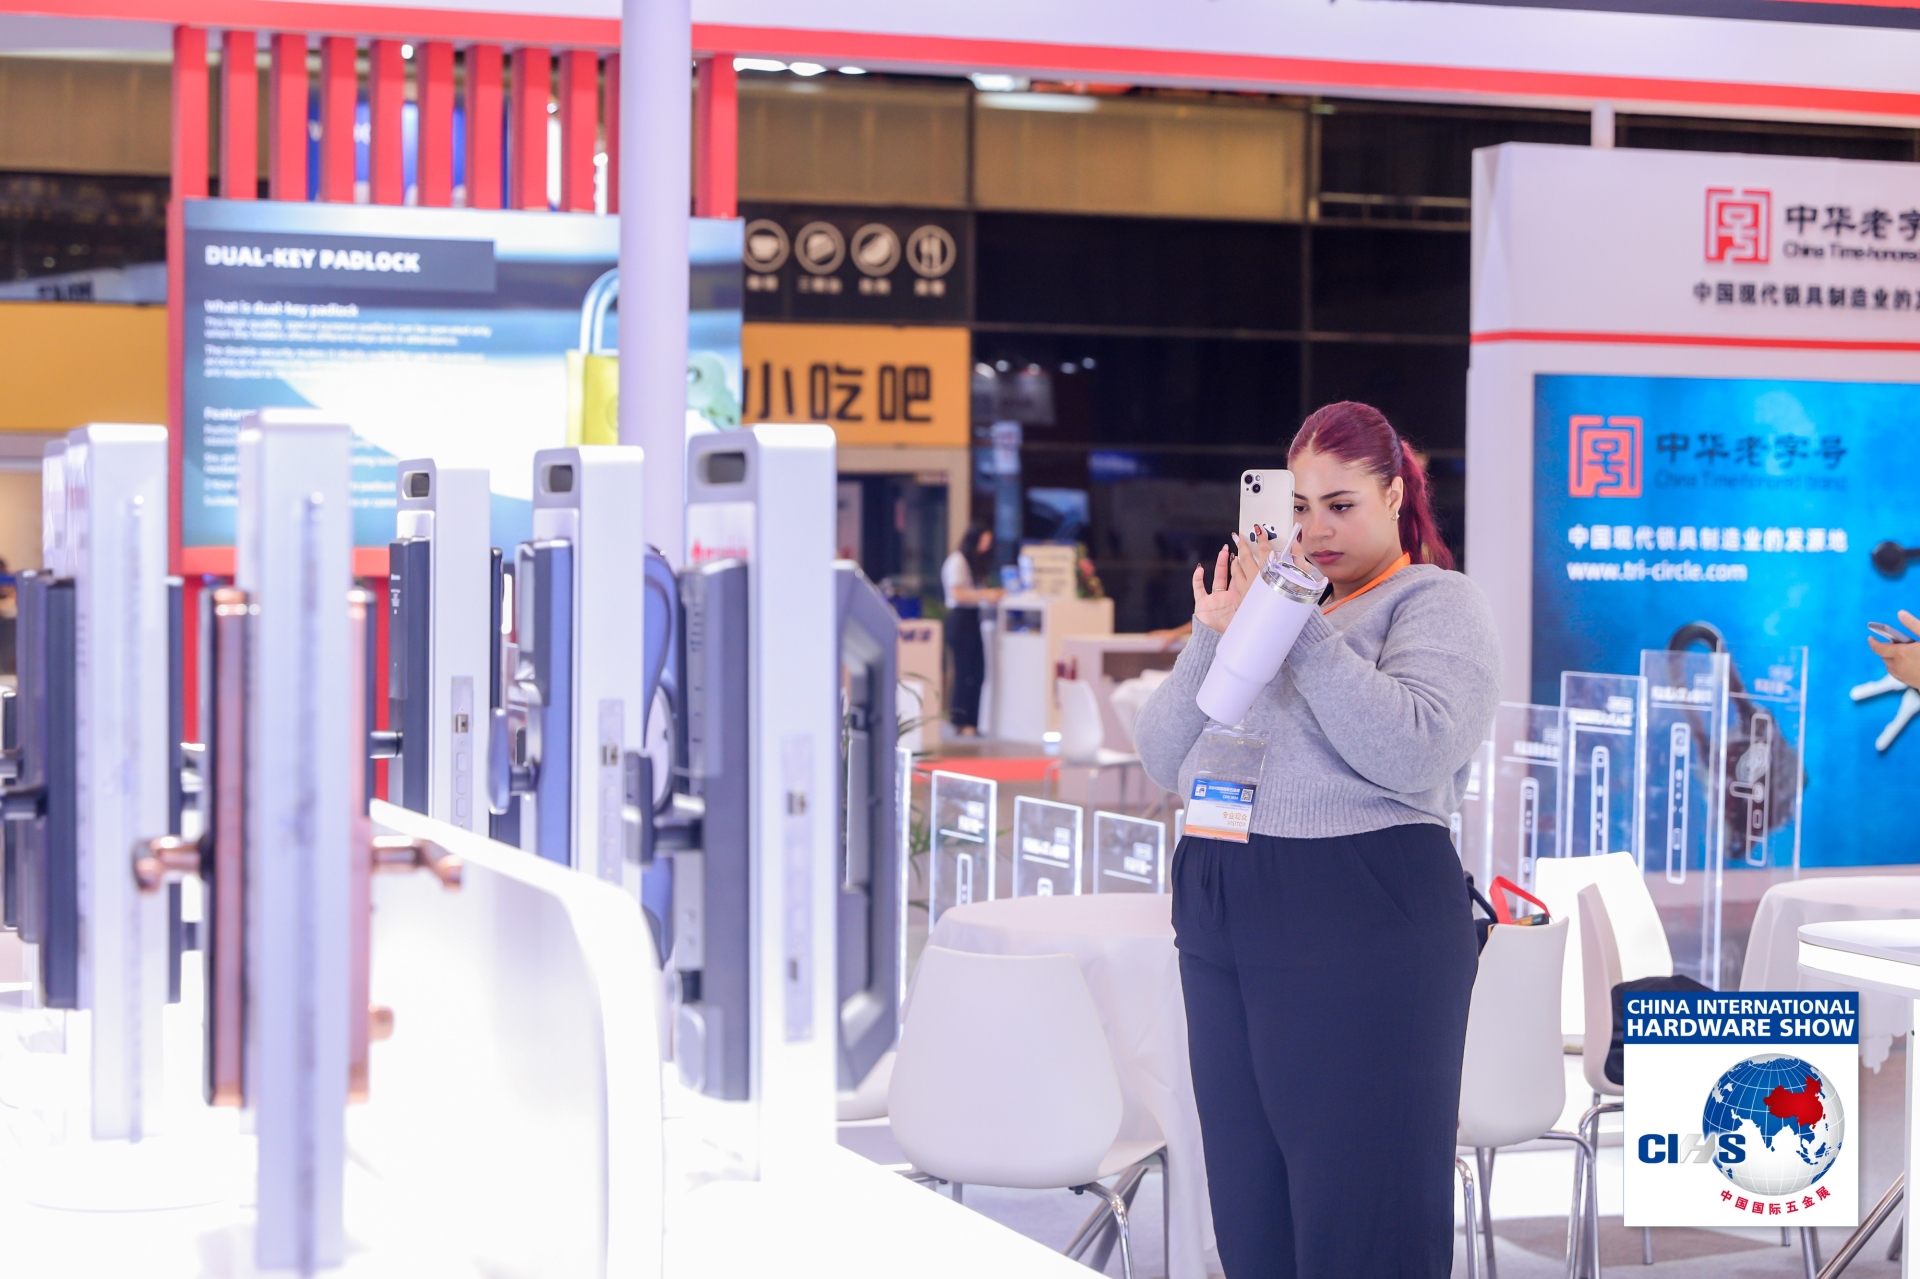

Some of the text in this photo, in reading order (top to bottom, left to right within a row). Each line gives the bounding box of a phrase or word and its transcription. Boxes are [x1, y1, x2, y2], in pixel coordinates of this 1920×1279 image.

[205, 245, 421, 273] DUAL-KEY PADLOCK
[1783, 241, 1823, 259] China
[204, 299, 360, 319] What is dual-key padlock
[743, 361, 932, 425] 小吃吧
[1657, 432, 1847, 470] 中华老字号
[1568, 524, 1848, 552] 中国现代锁具制造业的发源地
[1567, 559, 1748, 582] www.tri-circle.com
